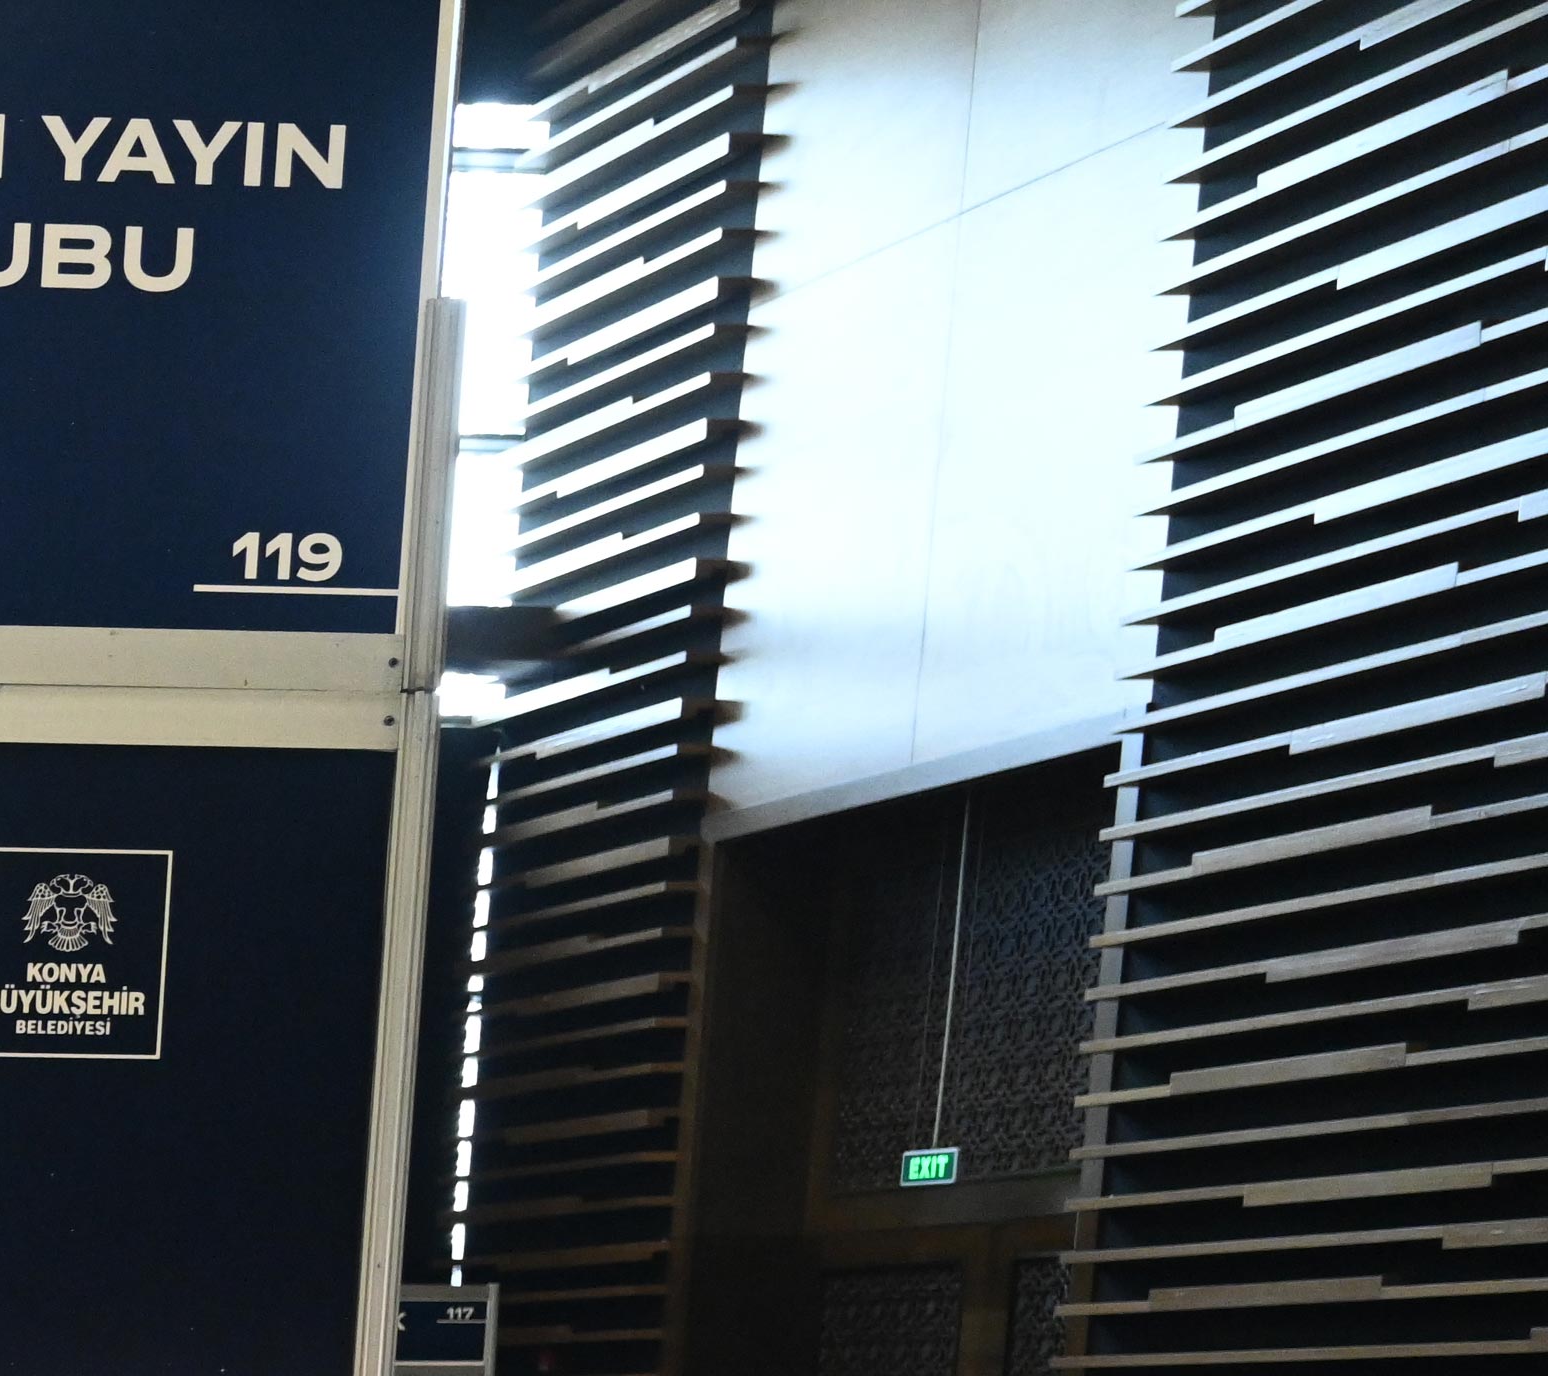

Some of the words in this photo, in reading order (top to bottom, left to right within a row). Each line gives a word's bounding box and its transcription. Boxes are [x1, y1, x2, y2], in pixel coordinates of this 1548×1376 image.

[43, 115, 347, 190] YAYIN
[232, 532, 343, 583] 119
[27, 962, 106, 984] KONYA
[15, 1017, 111, 1036] BELEDİYESİ
[909, 1154, 949, 1180] EXIT
[447, 1307, 474, 1320] 117
